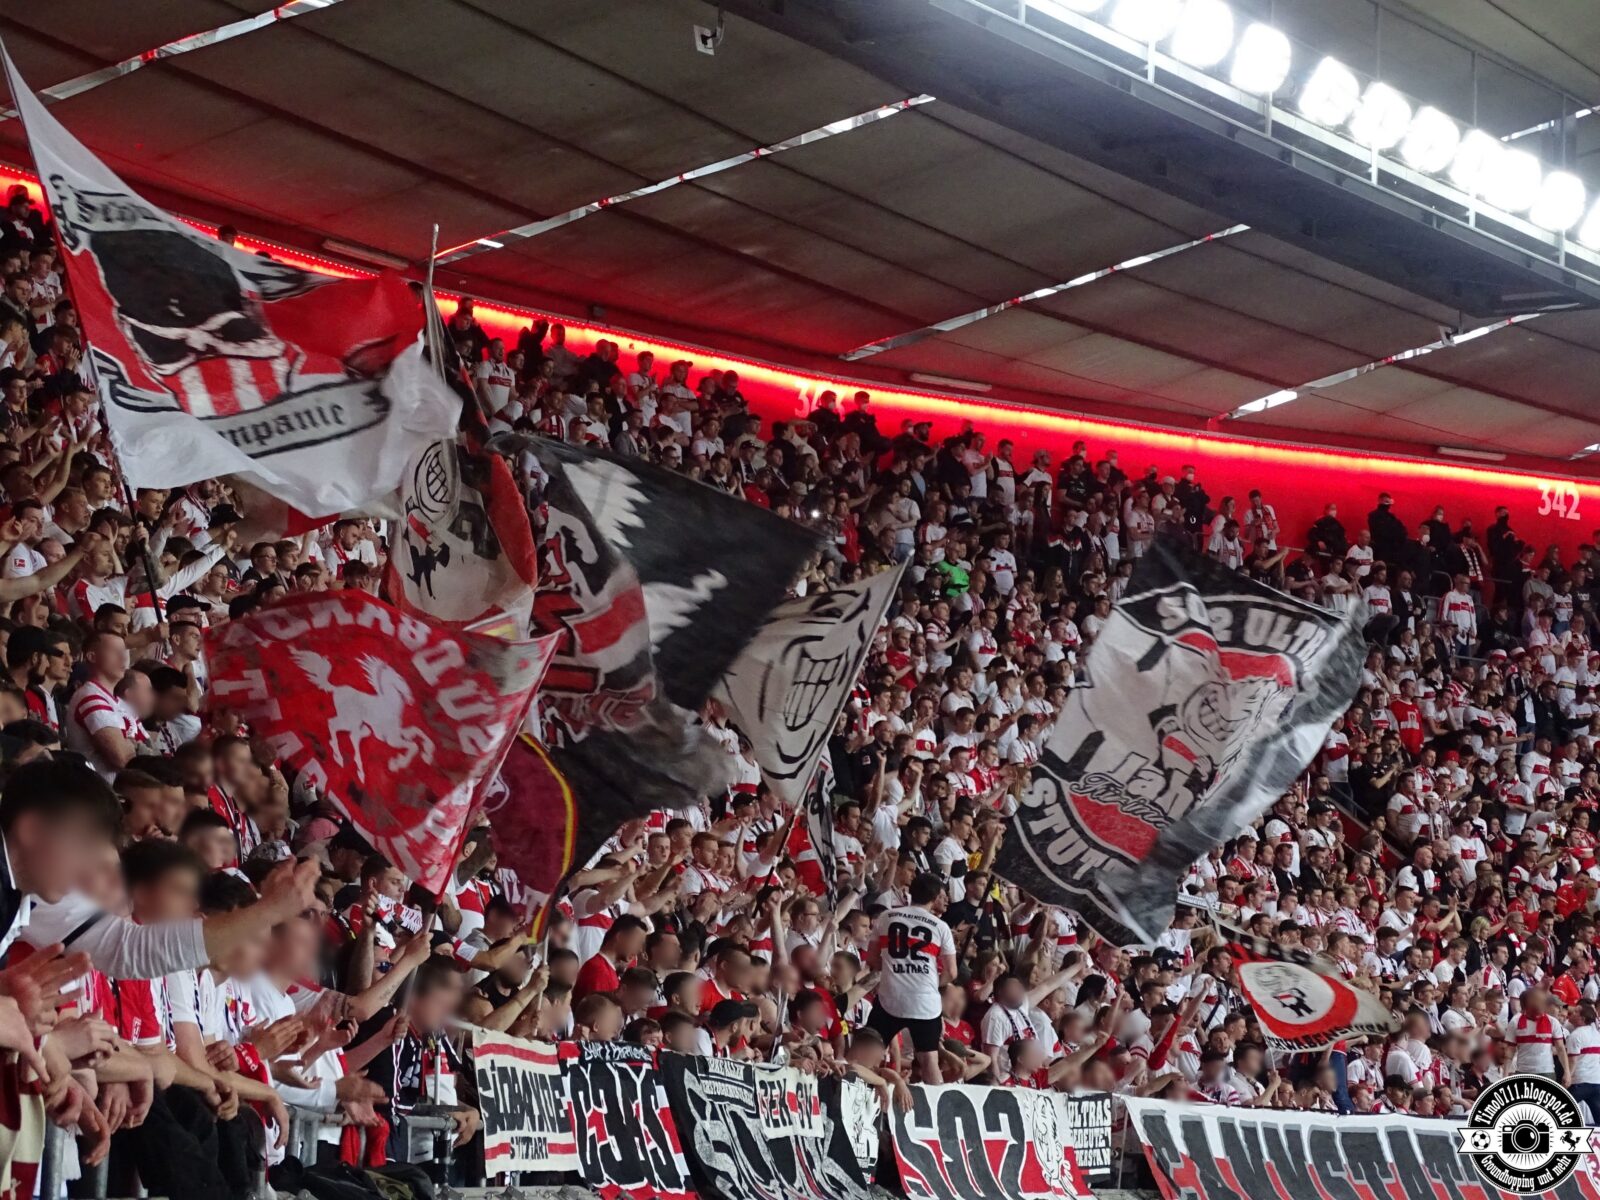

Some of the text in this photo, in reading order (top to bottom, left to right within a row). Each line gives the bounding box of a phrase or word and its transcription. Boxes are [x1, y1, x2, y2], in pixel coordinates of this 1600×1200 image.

[1538, 480, 1580, 520] 342
[888, 921, 933, 963] 02
[892, 963, 930, 975] ULTRAS
